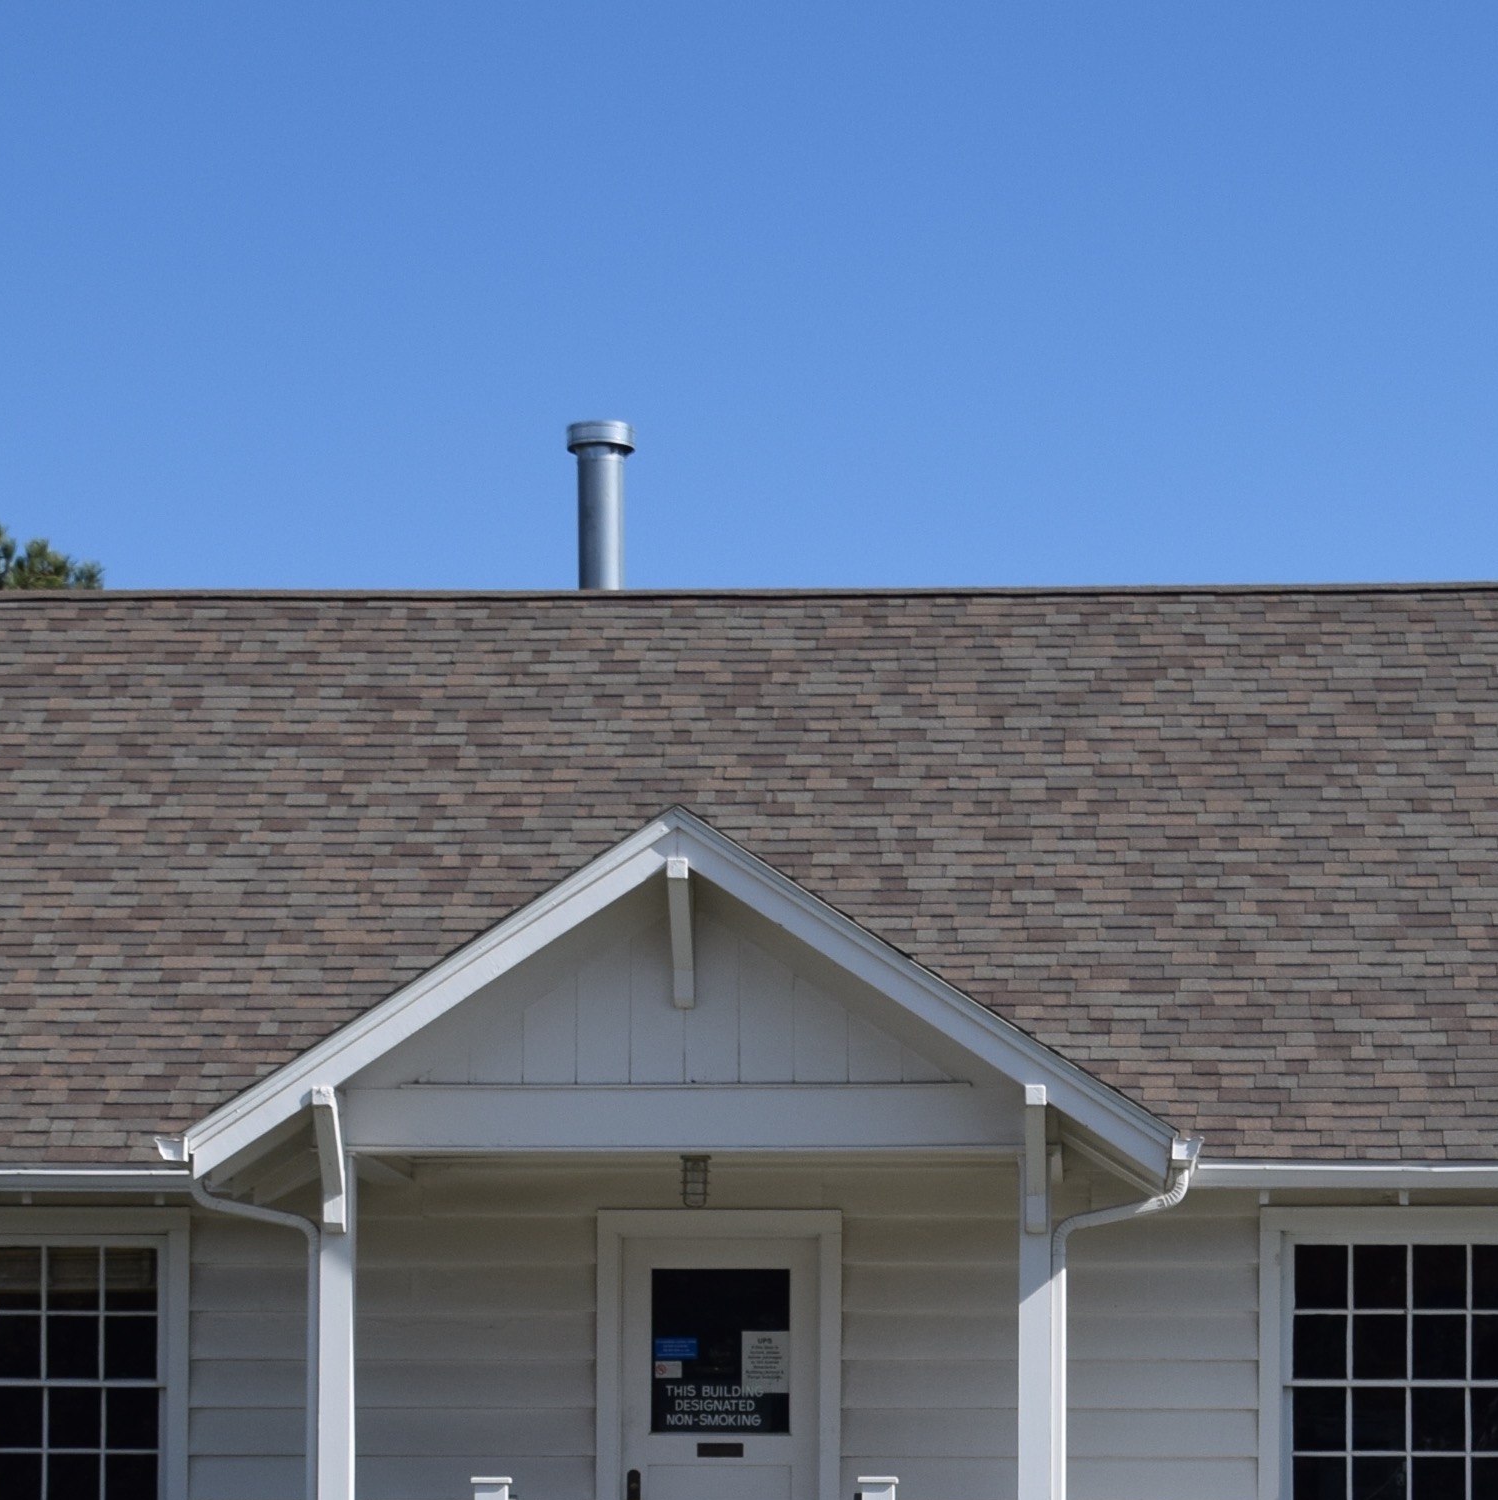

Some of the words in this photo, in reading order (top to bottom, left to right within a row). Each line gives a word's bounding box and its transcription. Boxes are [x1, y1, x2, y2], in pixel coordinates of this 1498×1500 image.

[665, 1385, 696, 1397] THIS
[701, 1385, 764, 1398] BUILDING
[675, 1399, 755, 1411] DESIGNATED
[666, 1414, 761, 1426] NON-SMOKING
